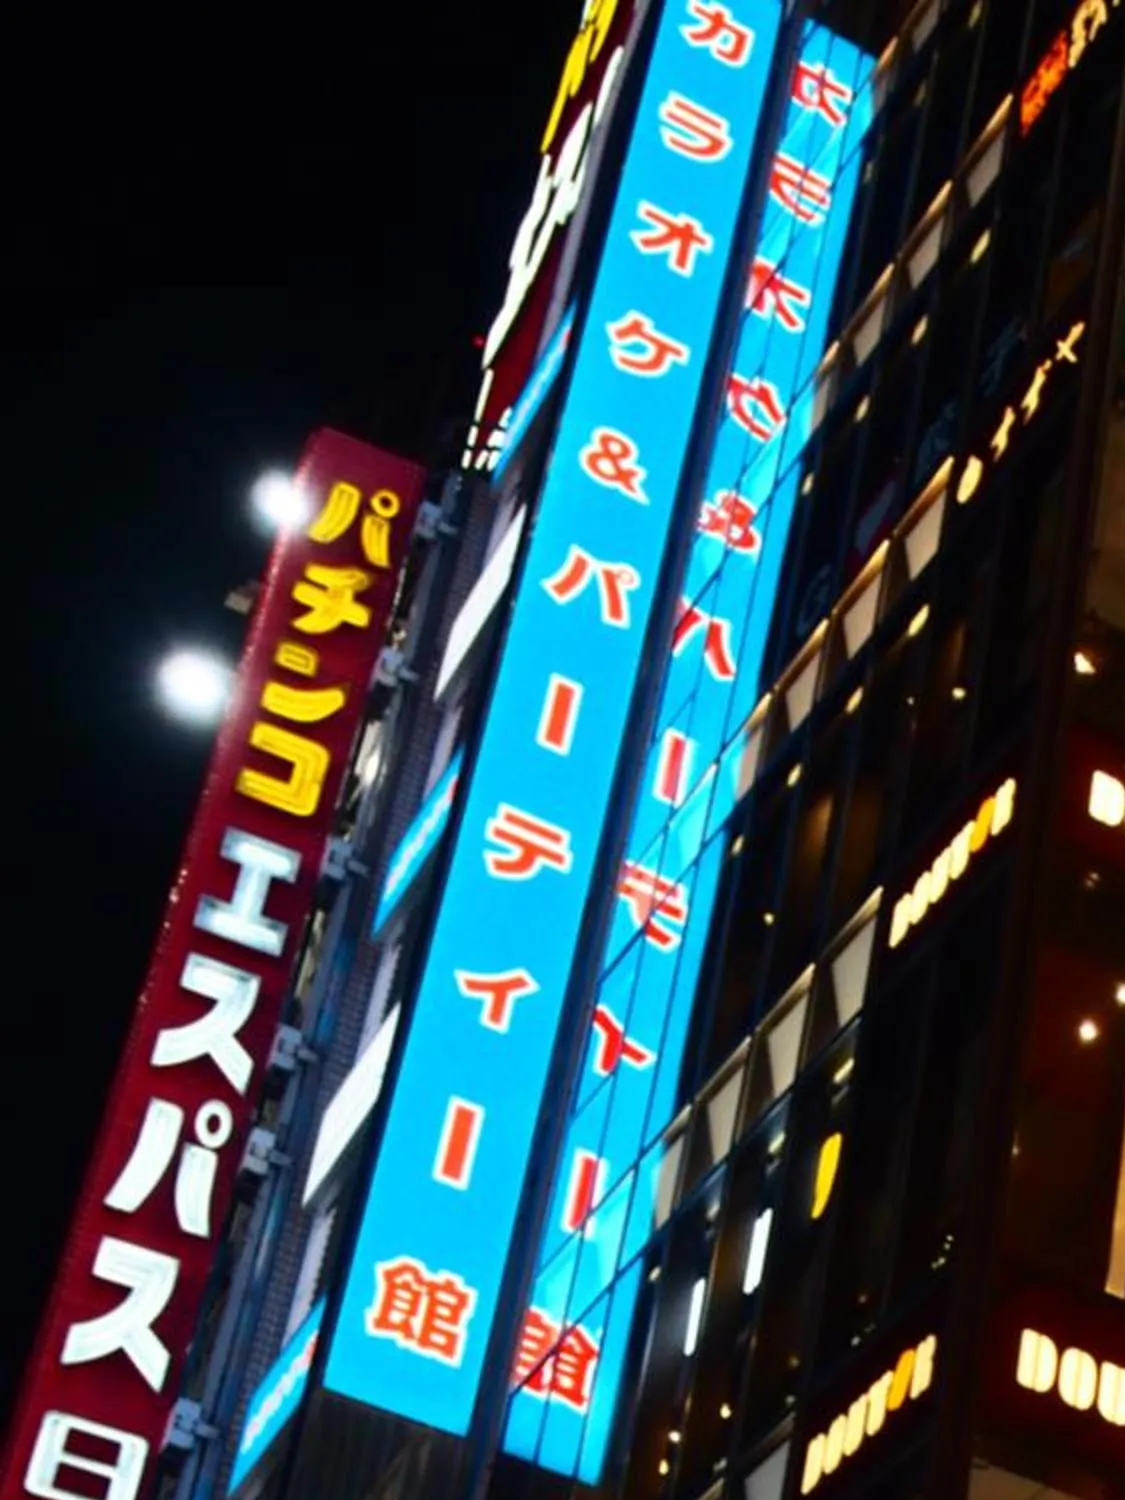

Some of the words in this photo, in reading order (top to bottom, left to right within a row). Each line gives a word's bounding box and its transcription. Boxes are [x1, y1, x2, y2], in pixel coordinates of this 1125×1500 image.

[237, 482, 400, 816] パチンコ
[366, 0, 755, 1365] カラオケ&パーティー館
